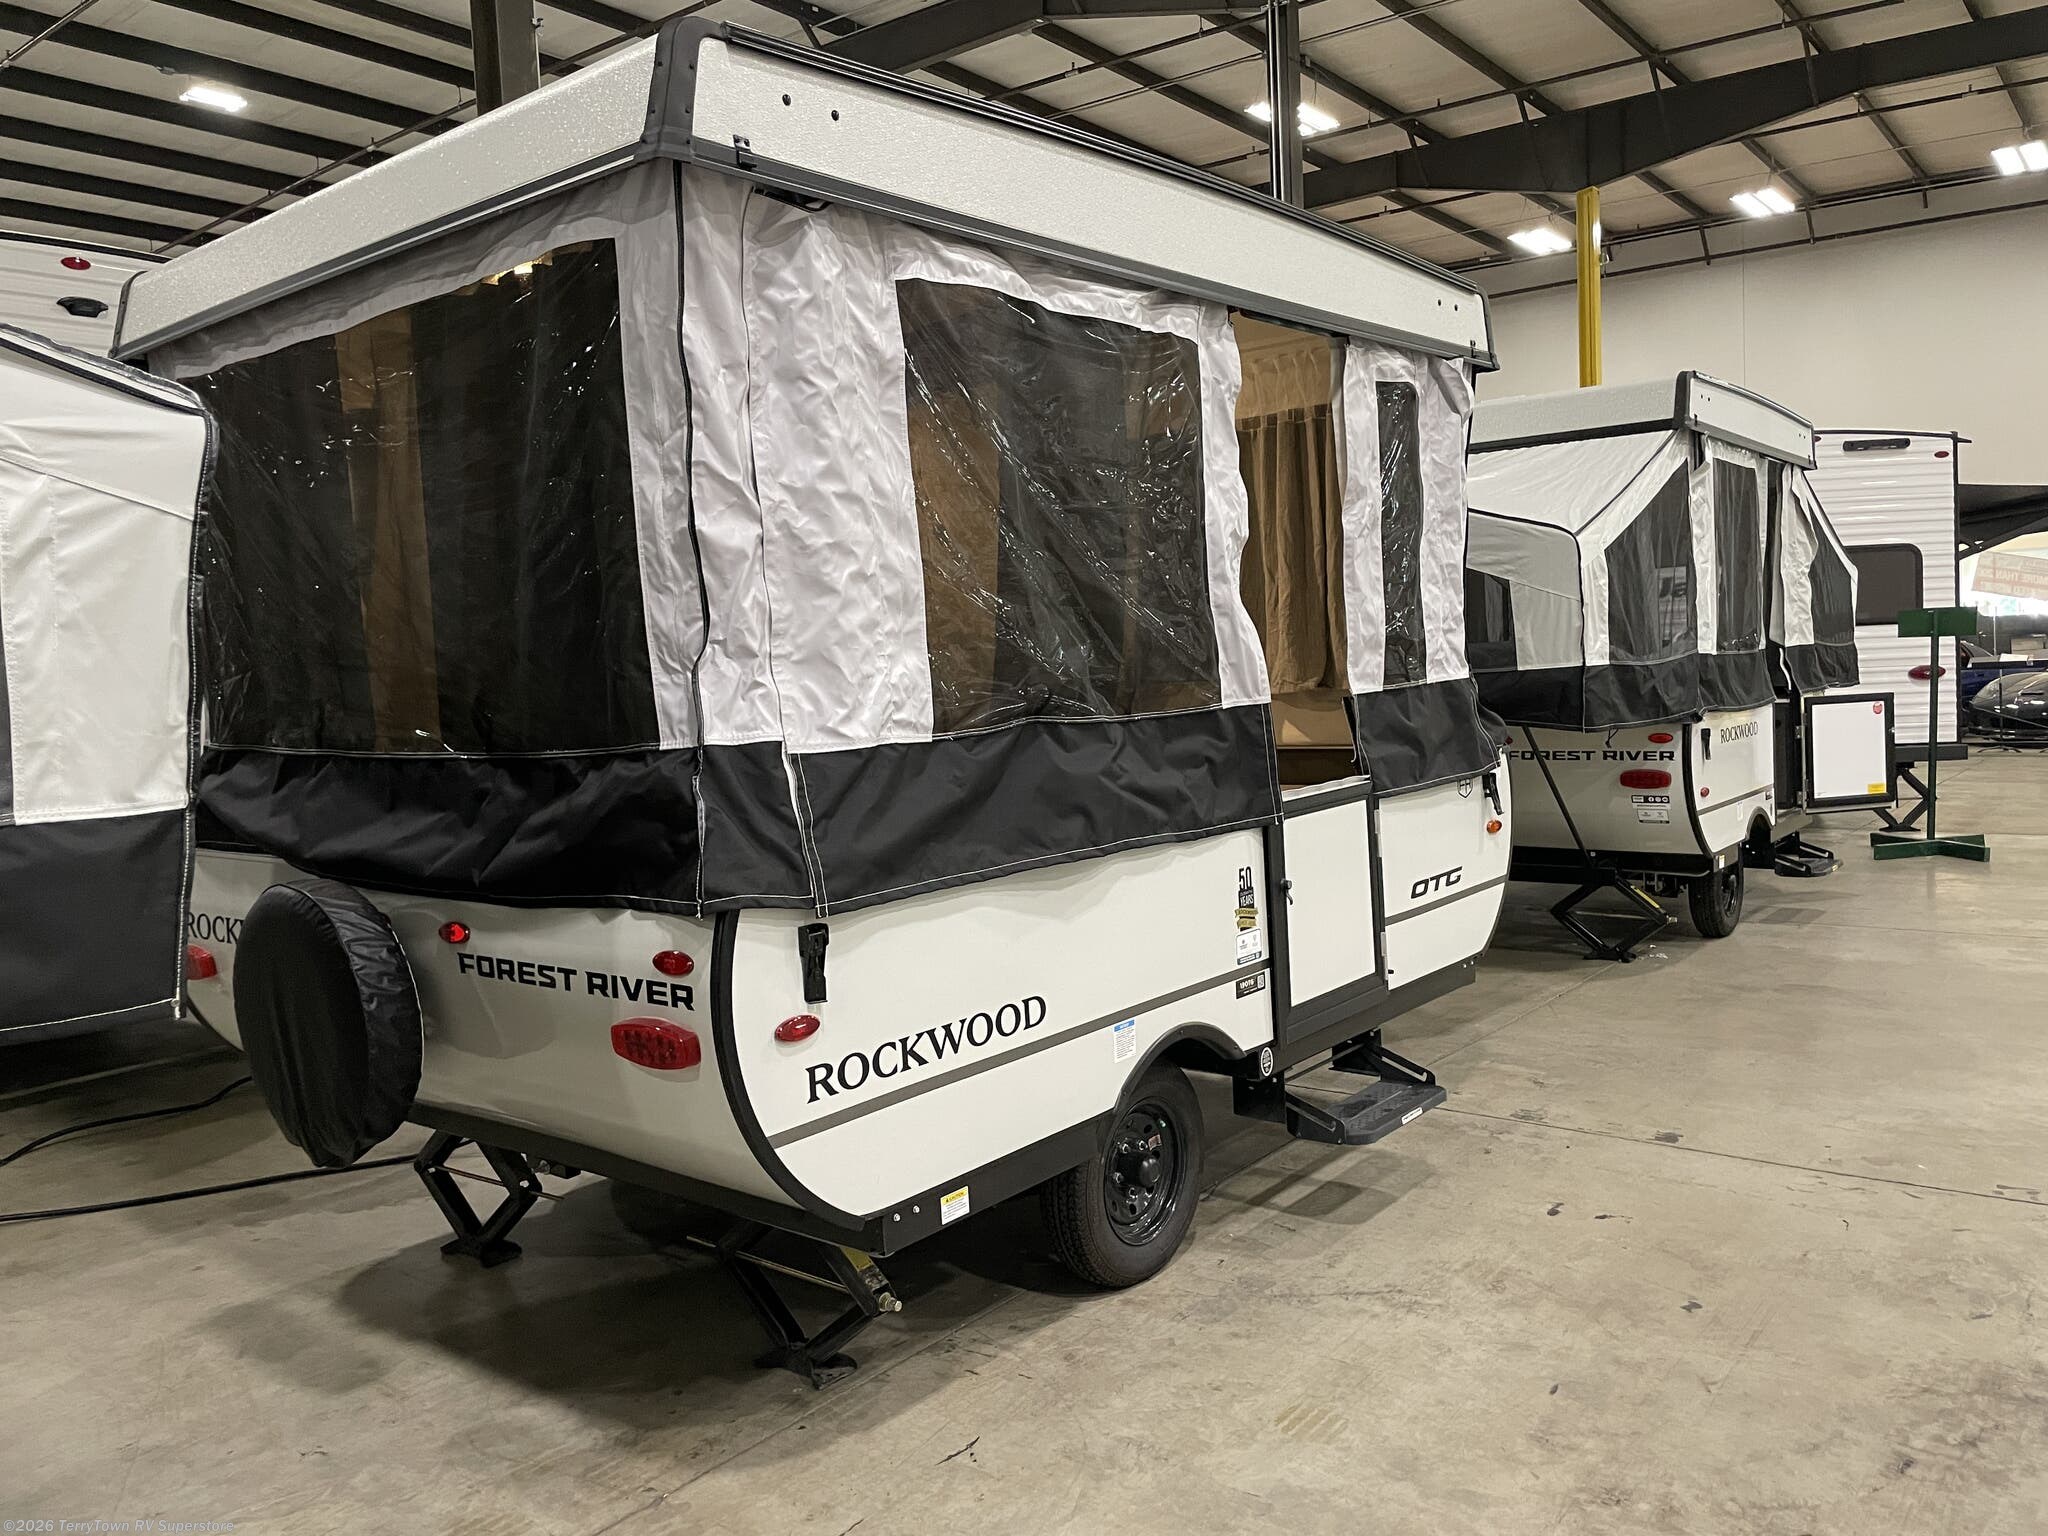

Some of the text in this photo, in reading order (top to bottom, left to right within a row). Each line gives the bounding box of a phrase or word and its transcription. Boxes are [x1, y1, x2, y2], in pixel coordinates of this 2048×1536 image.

[1720, 721, 1759, 744] ROCKWOOD
[1509, 749, 1675, 762] FOREST RIVER
[1238, 866, 1252, 890] 50
[1410, 866, 1463, 899] OTG
[1240, 892, 1254, 907] YEARS
[188, 912, 245, 944] ROCK
[457, 952, 695, 1011] FOREST RIVER
[806, 995, 1048, 1104] ROCKWOOD
